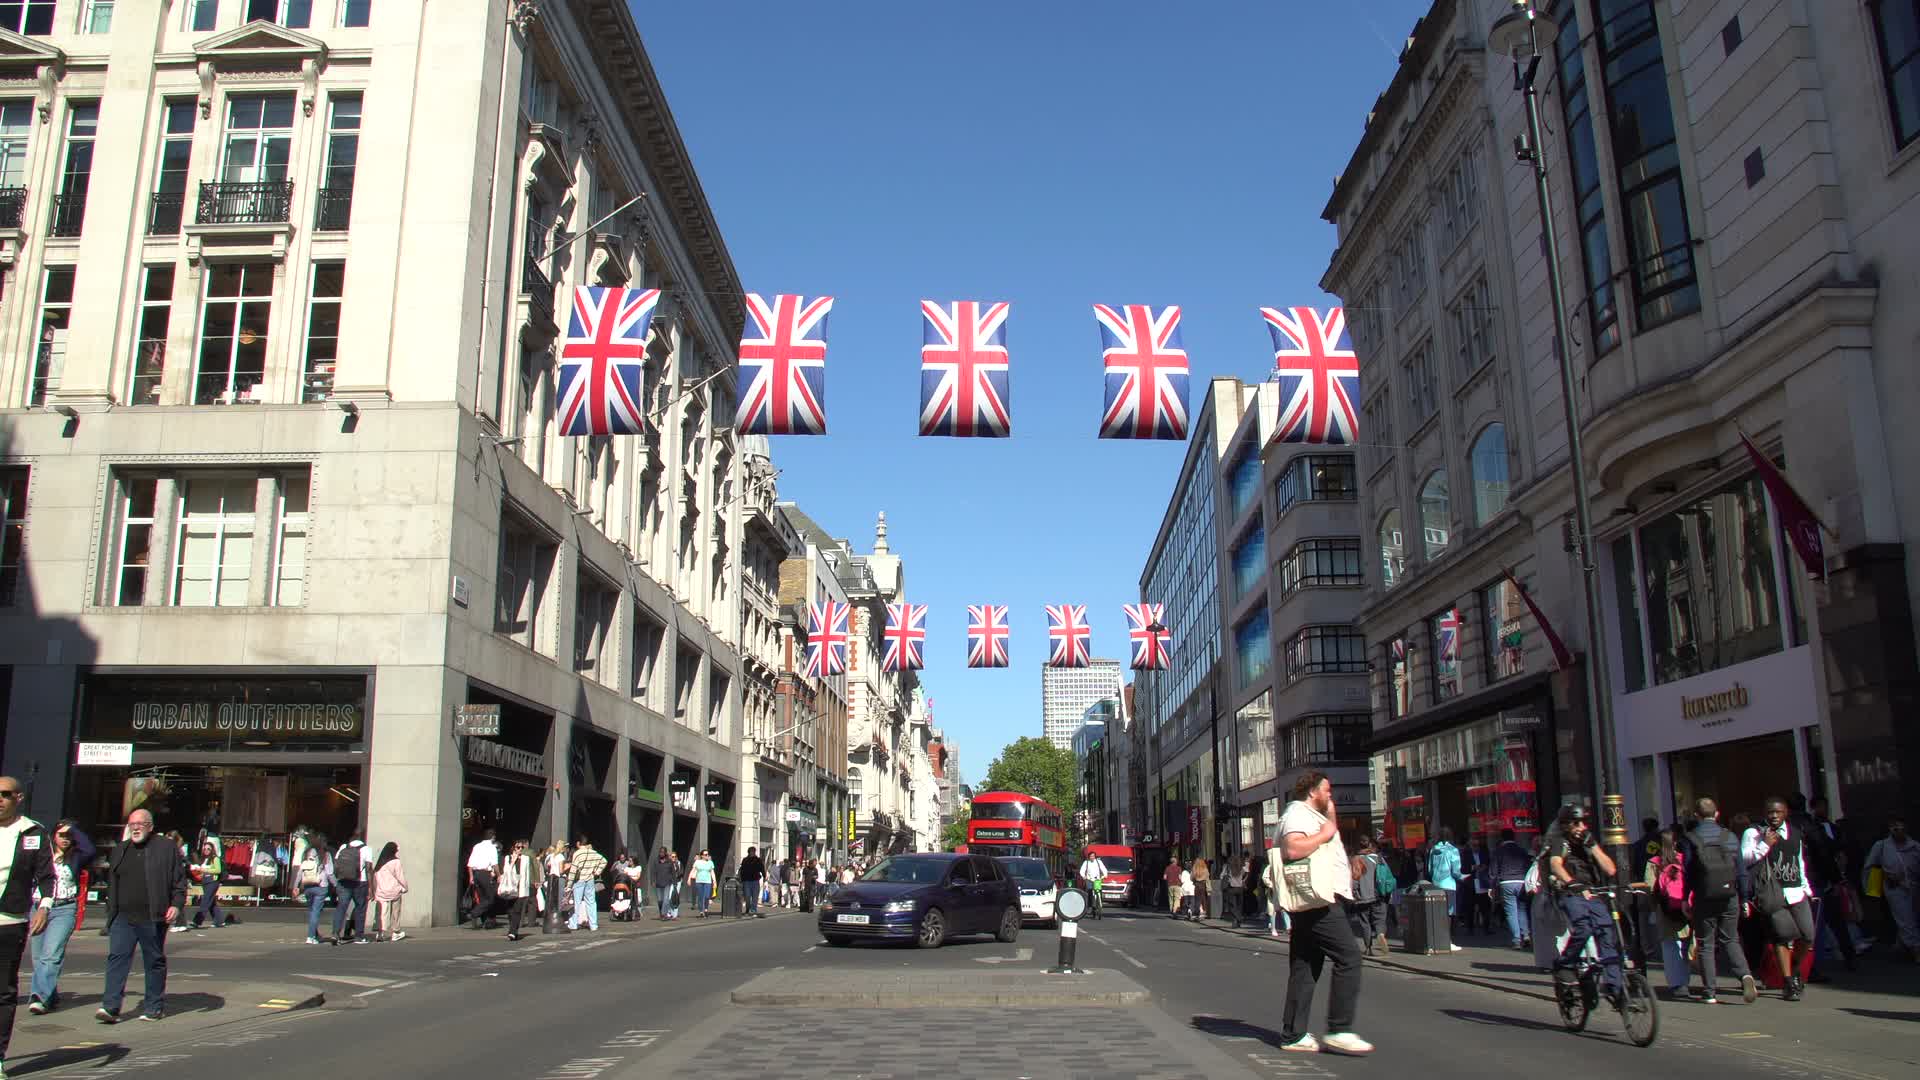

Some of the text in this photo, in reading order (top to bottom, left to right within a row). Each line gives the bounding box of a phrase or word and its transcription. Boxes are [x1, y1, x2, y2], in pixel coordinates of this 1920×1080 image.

[132, 703, 355, 732] URBAN OUTFITTERS
[1426, 750, 1465, 774] BERSHKA
